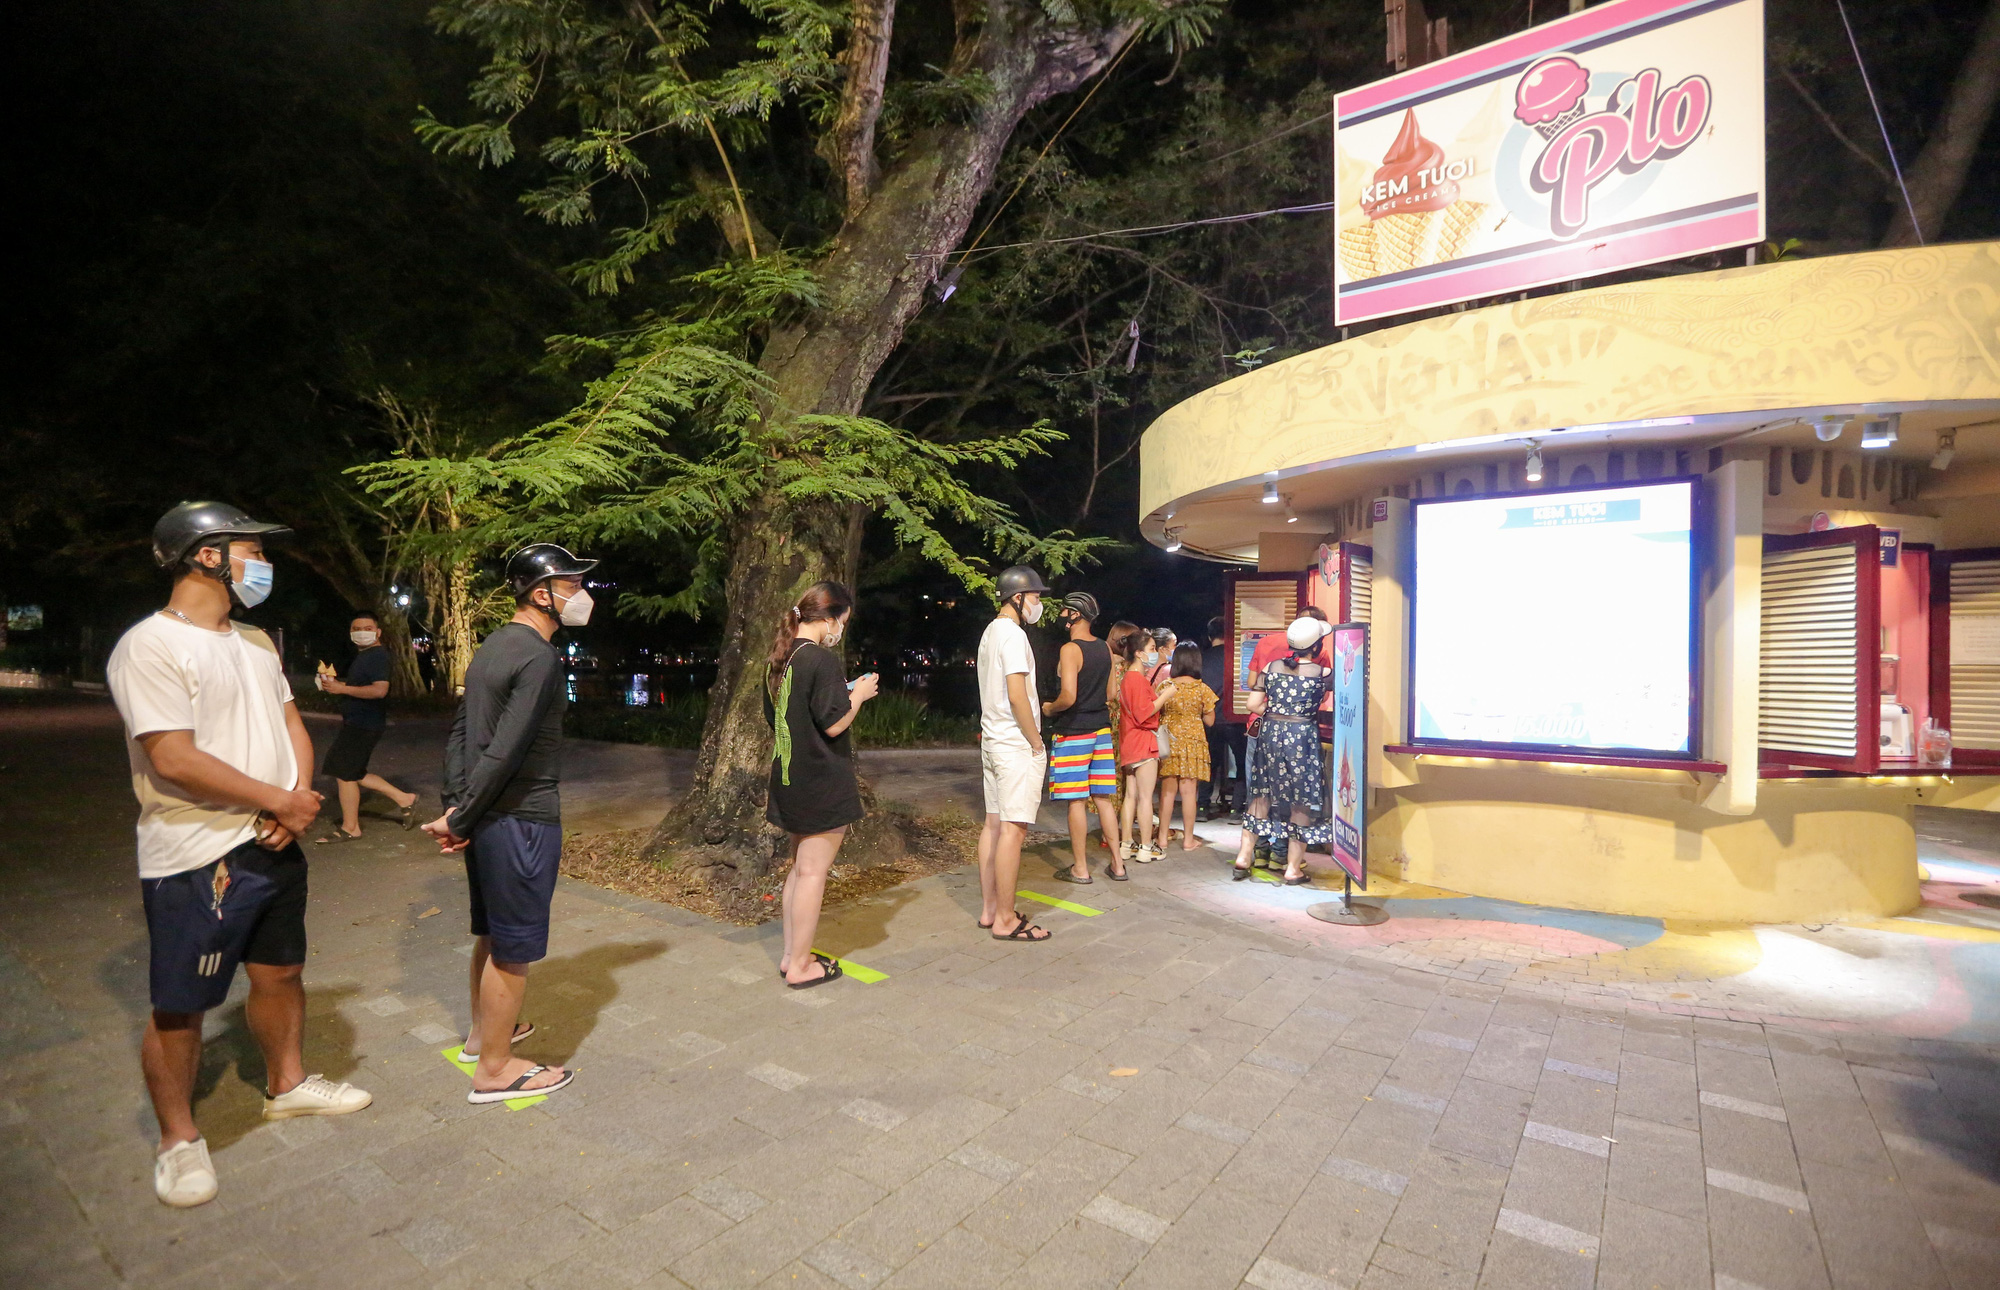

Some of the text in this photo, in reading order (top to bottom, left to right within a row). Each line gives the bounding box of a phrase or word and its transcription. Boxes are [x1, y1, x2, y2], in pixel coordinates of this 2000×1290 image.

[1361, 157, 1474, 205] KEM TƯƠI
[1376, 185, 1457, 213] ICE CREAMS
[1533, 506, 1565, 520] KEM
